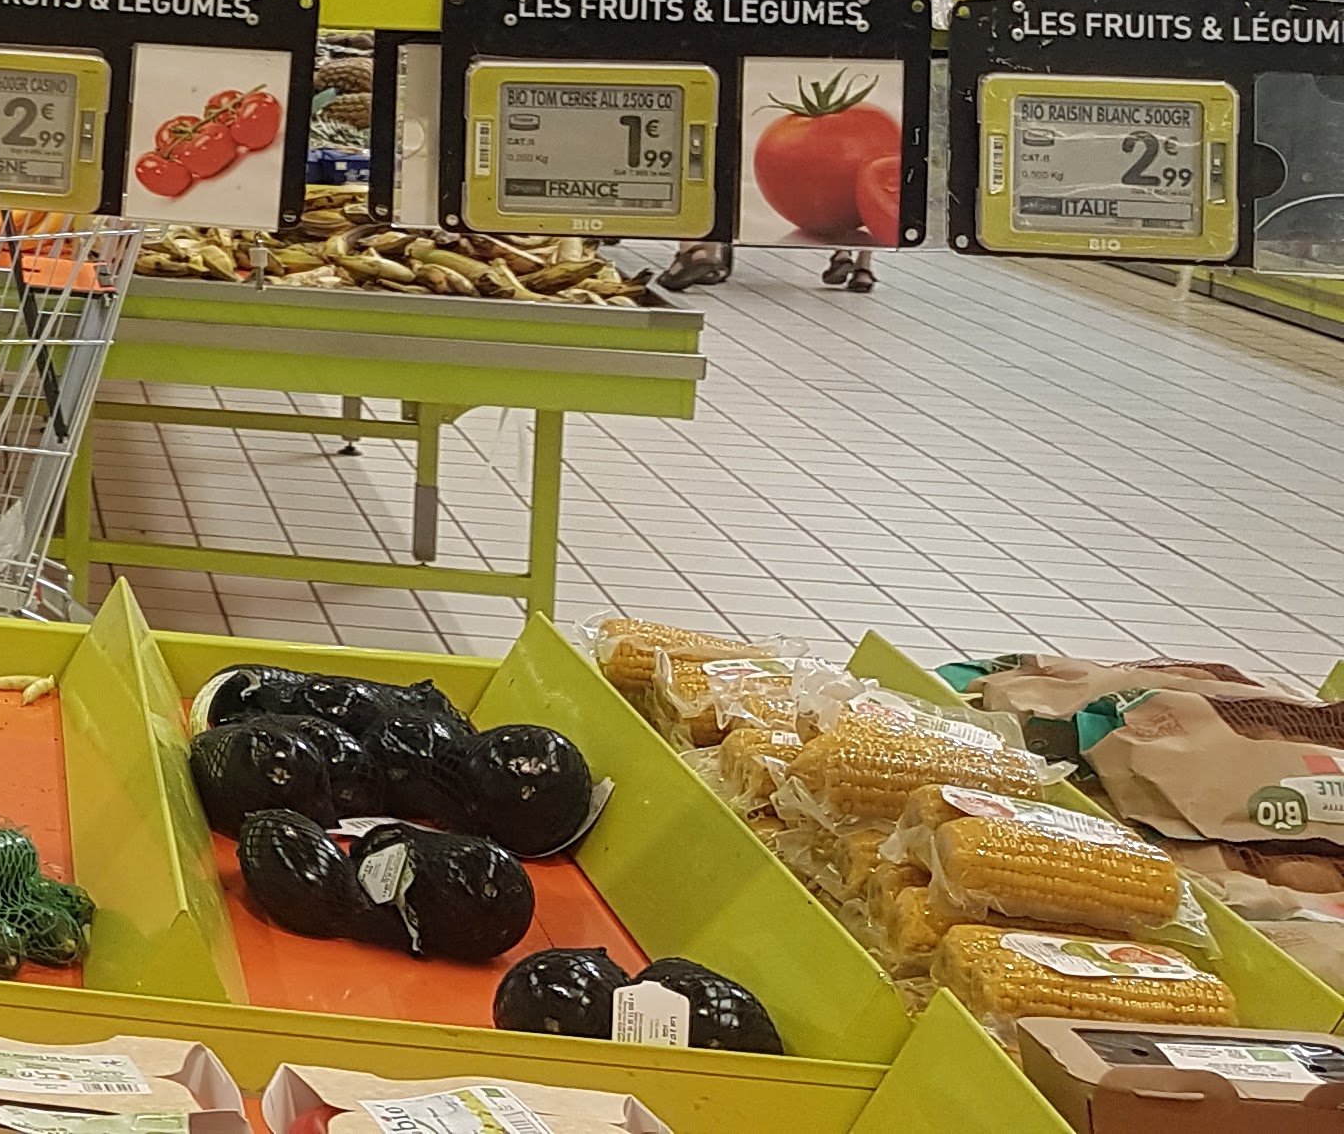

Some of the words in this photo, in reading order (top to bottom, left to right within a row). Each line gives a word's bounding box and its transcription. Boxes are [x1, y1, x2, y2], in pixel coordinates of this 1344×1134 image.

[1023, 11, 1077, 36] LES
[1085, 13, 1193, 41] FRUITS
[1201, 15, 1224, 42] &
[30, 77, 68, 94] CASINO
[508, 89, 528, 106] BIO
[530, 89, 558, 106] TOM
[560, 91, 598, 107] CERISE
[600, 92, 620, 107] ALL
[623, 93, 654, 108] 250G
[1021, 103, 1045, 121] BIO
[1049, 104, 1093, 123] RAISIN
[1097, 106, 1141, 124] BLANC
[1144, 107, 1191, 126] 500GR
[548, 181, 619, 198] FRANCE
[1064, 199, 1119, 216] ITALIE
[572, 218, 603, 231] BIO
[1089, 238, 1121, 251] BIO
